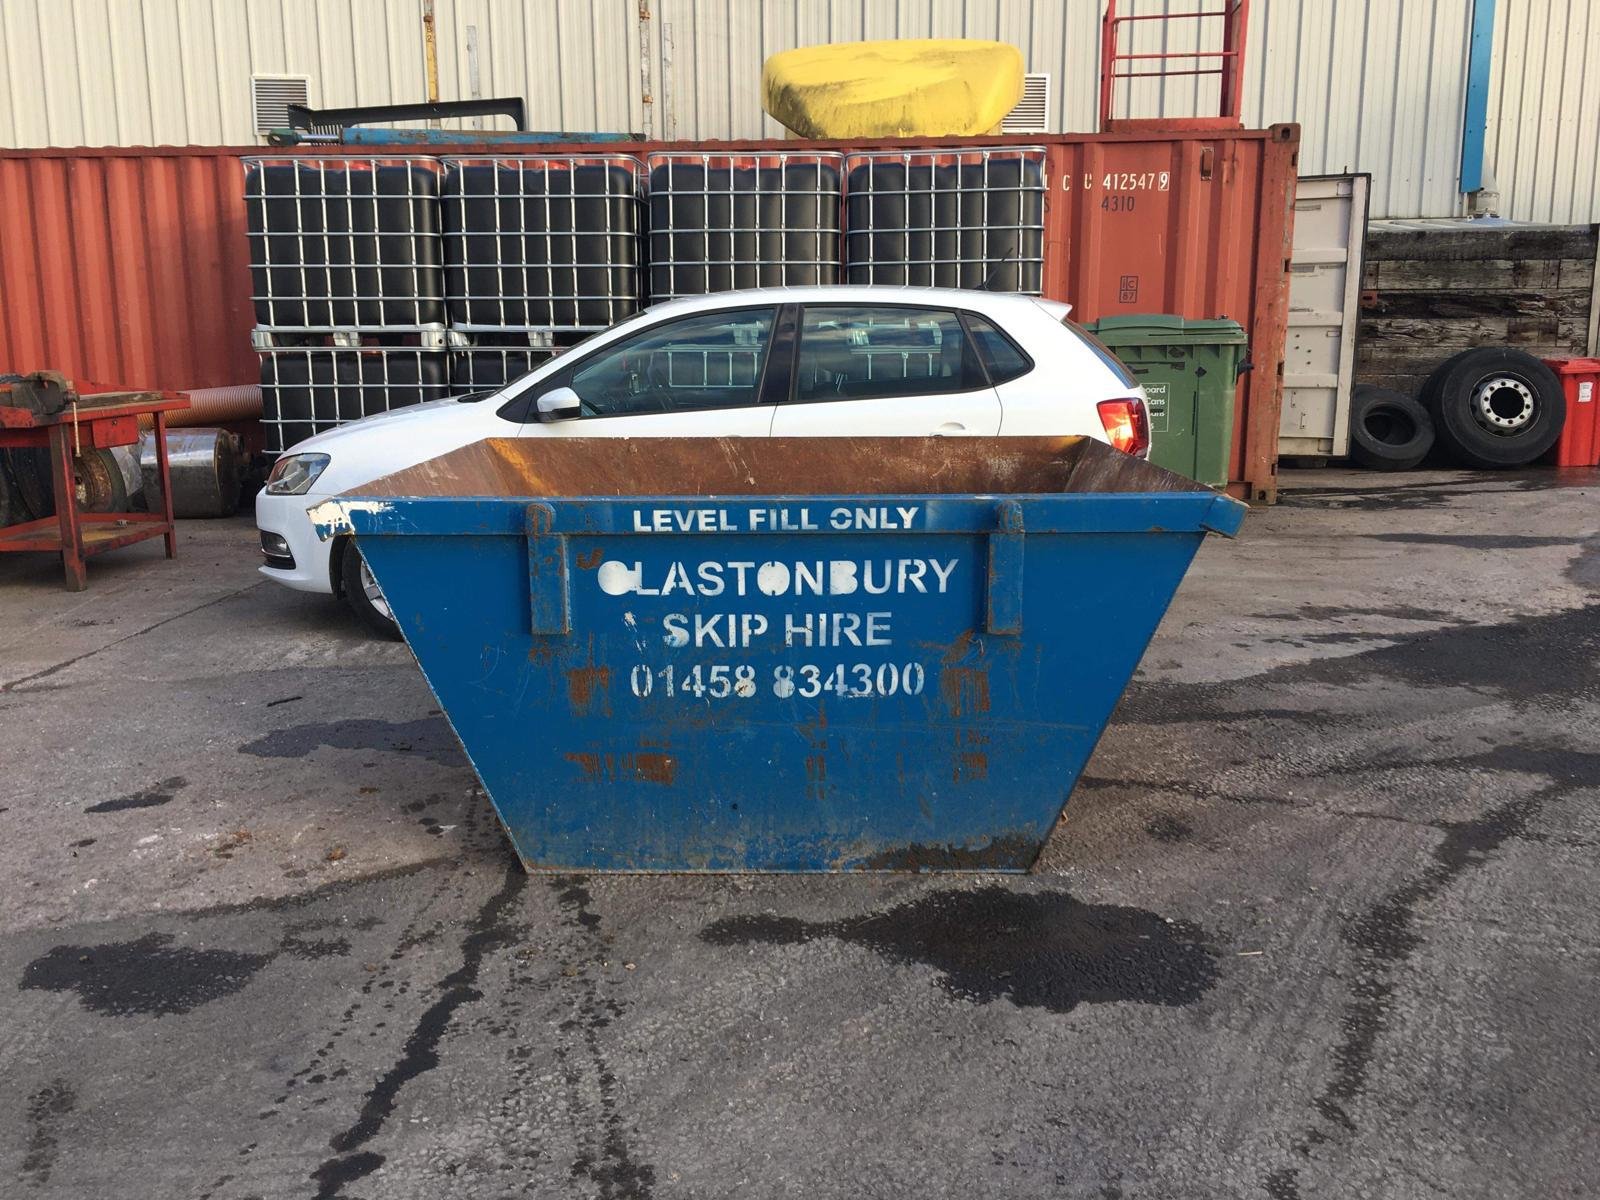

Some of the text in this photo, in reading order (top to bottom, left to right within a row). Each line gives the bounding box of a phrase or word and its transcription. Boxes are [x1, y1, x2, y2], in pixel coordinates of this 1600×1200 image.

[1101, 195, 1135, 212] 4310
[633, 506, 920, 532] LEVEL FILL ONLY
[662, 611, 893, 648] SKIP HIRE
[630, 662, 925, 699] 01458 834300
